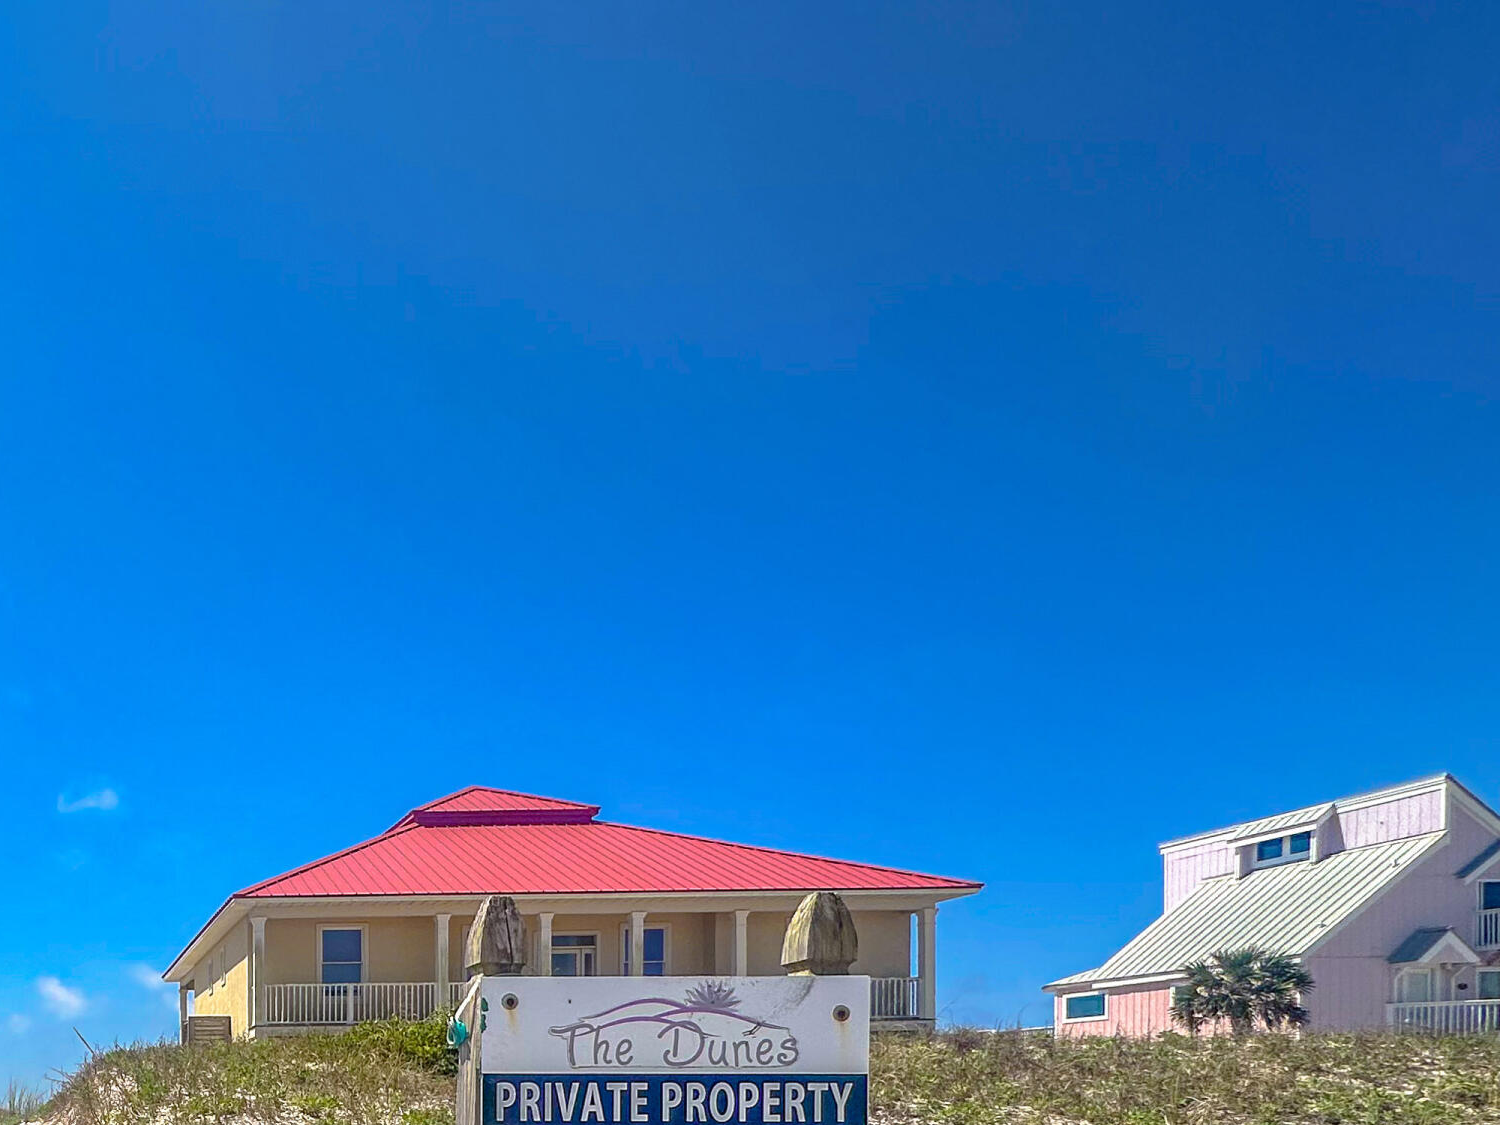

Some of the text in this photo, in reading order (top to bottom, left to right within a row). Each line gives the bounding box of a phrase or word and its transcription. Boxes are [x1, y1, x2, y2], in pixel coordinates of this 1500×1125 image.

[548, 1020, 800, 1067] The Dunes
[496, 1081, 854, 1123] PRIVATE PROPERTY
